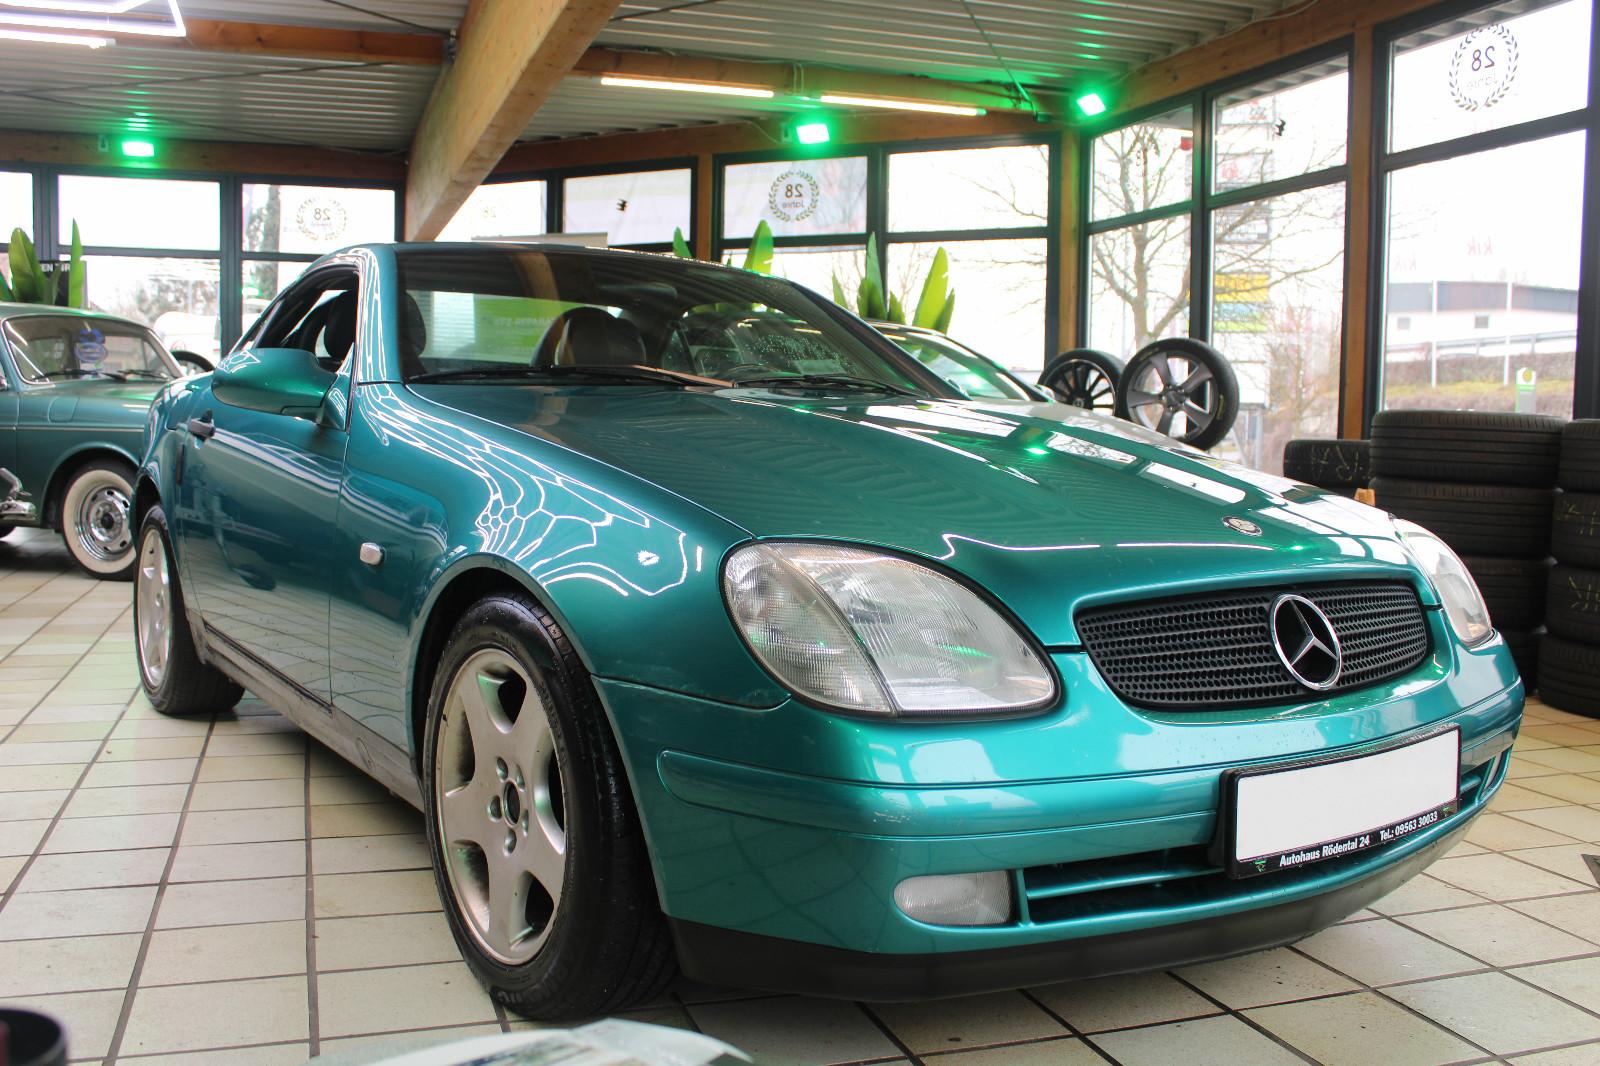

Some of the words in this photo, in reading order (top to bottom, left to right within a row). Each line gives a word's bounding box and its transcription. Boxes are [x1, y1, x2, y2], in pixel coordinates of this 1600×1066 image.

[39, 263, 54, 272] EN
[1279, 851, 1320, 867] Autohaus
[1322, 840, 1358, 857] Rödental
[1358, 835, 1370, 848] 24
[1379, 829, 1394, 841] Tel.:
[1395, 820, 1417, 836] 09563
[1418, 811, 1438, 827] 30033
